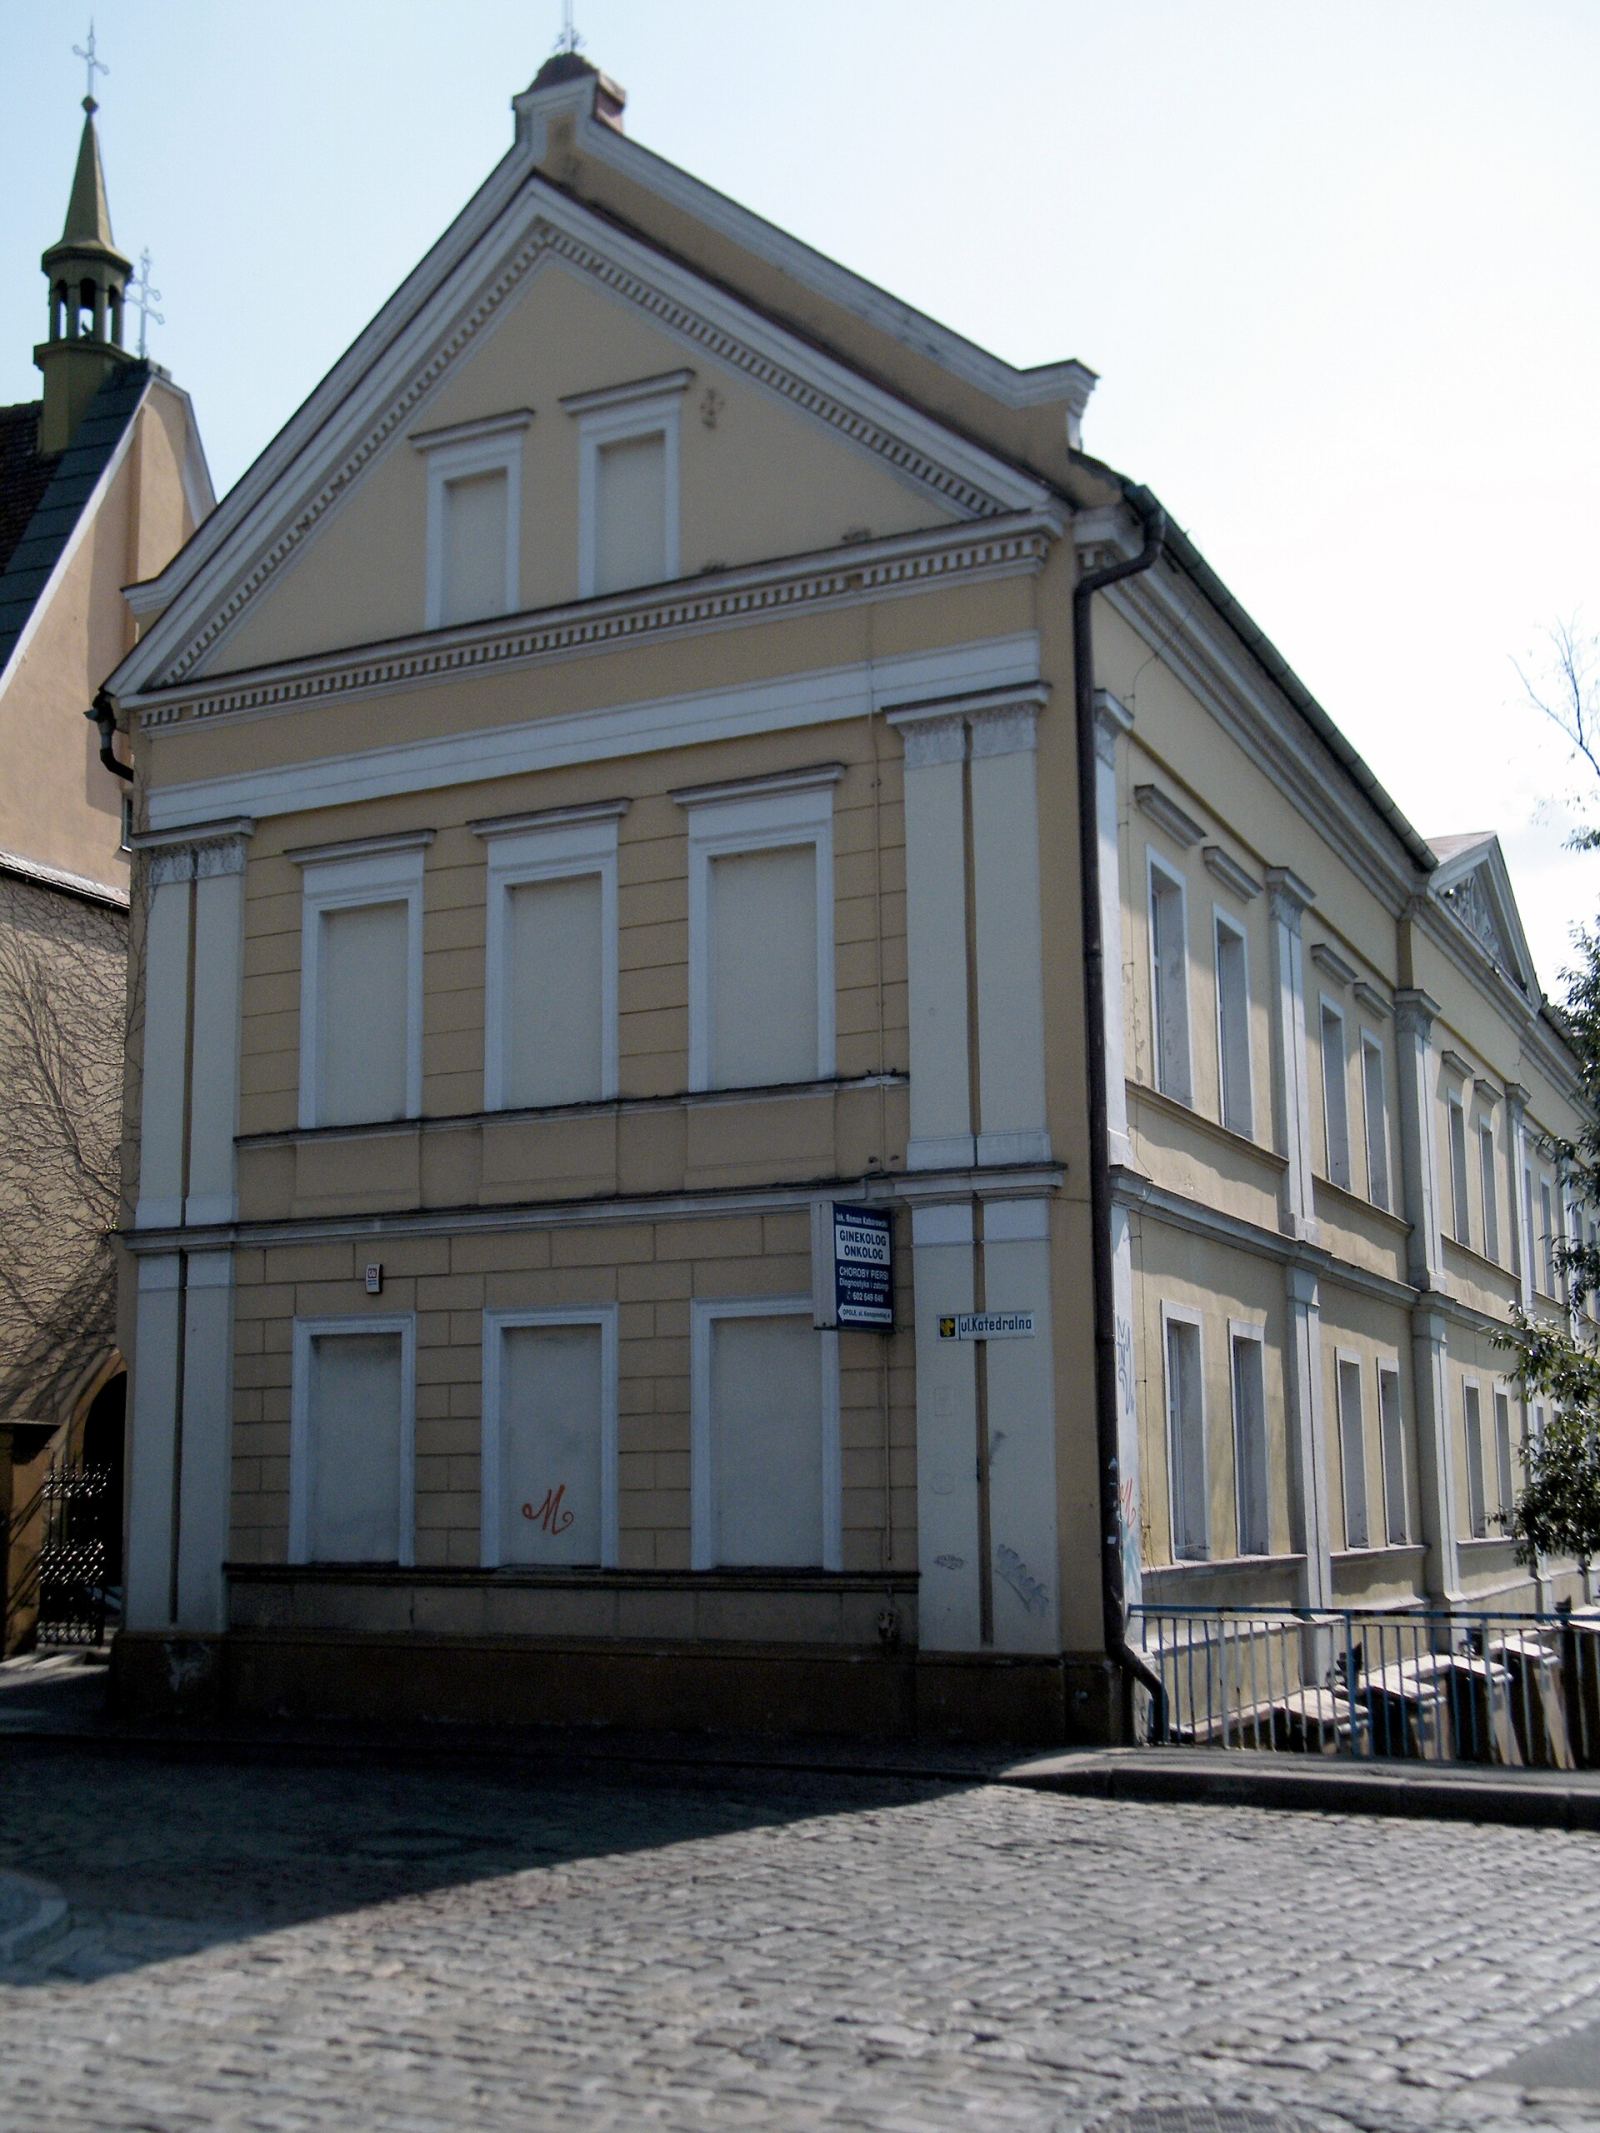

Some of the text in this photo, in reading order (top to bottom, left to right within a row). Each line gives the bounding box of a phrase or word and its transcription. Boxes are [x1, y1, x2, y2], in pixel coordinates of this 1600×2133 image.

[839, 1229, 887, 1246] GINEKOLOG
[844, 1245, 884, 1260] ONKOLOG
[839, 1266, 869, 1278] CHOROBY
